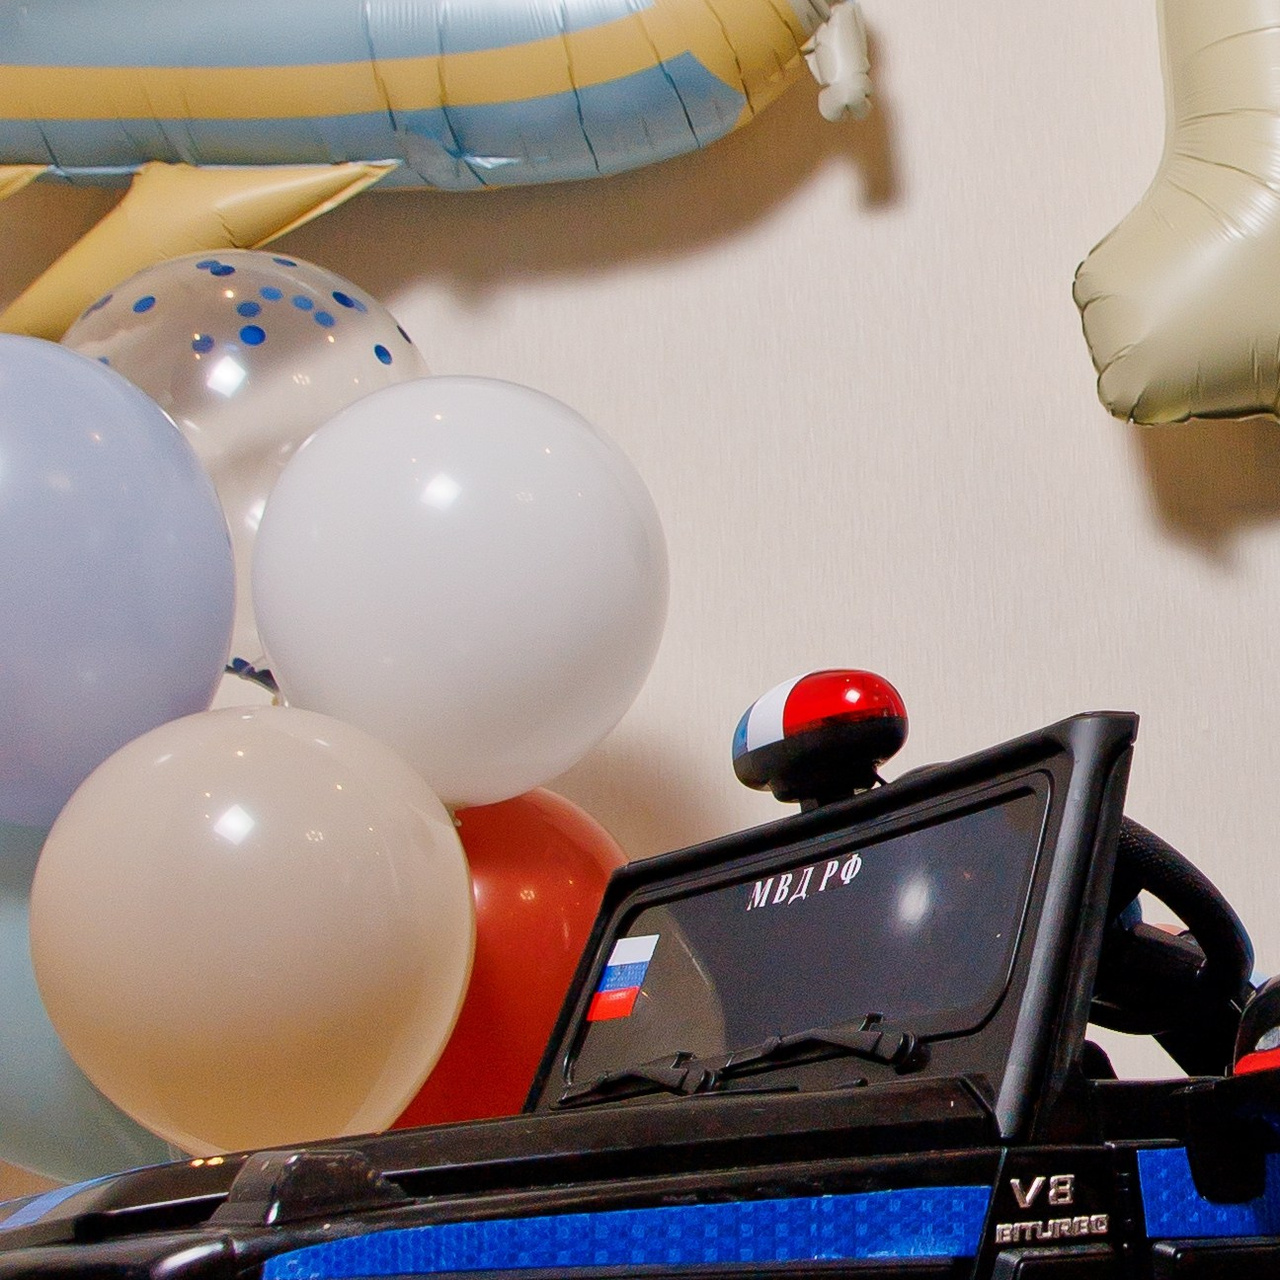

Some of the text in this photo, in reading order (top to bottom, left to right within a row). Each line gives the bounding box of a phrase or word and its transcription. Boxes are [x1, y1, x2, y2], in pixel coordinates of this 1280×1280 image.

[746, 852, 863, 911] МВД РФ
[1009, 1173, 1076, 1209] V8
